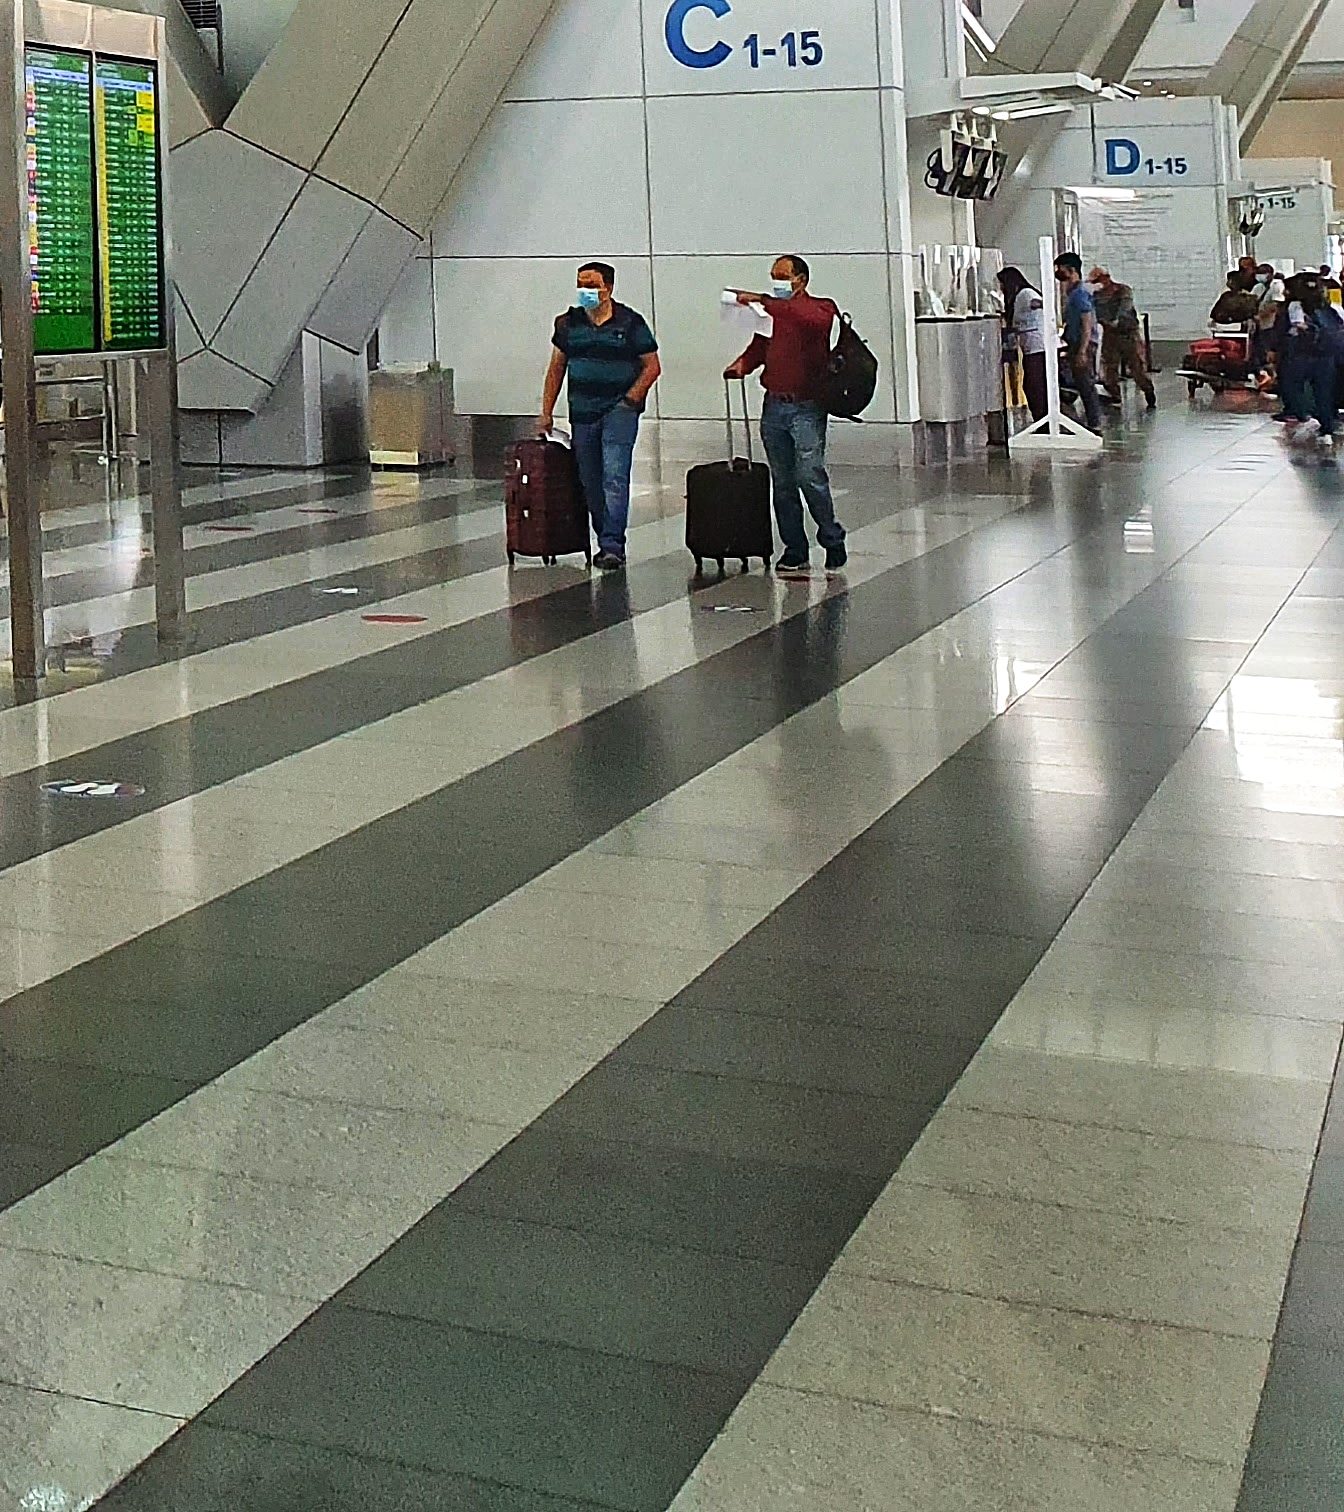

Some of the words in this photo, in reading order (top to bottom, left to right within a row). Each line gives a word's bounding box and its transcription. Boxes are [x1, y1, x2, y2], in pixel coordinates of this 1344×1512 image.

[743, 30, 824, 68] 1-15
[1105, 138, 1141, 176] D
[1145, 157, 1188, 175] 1-15
